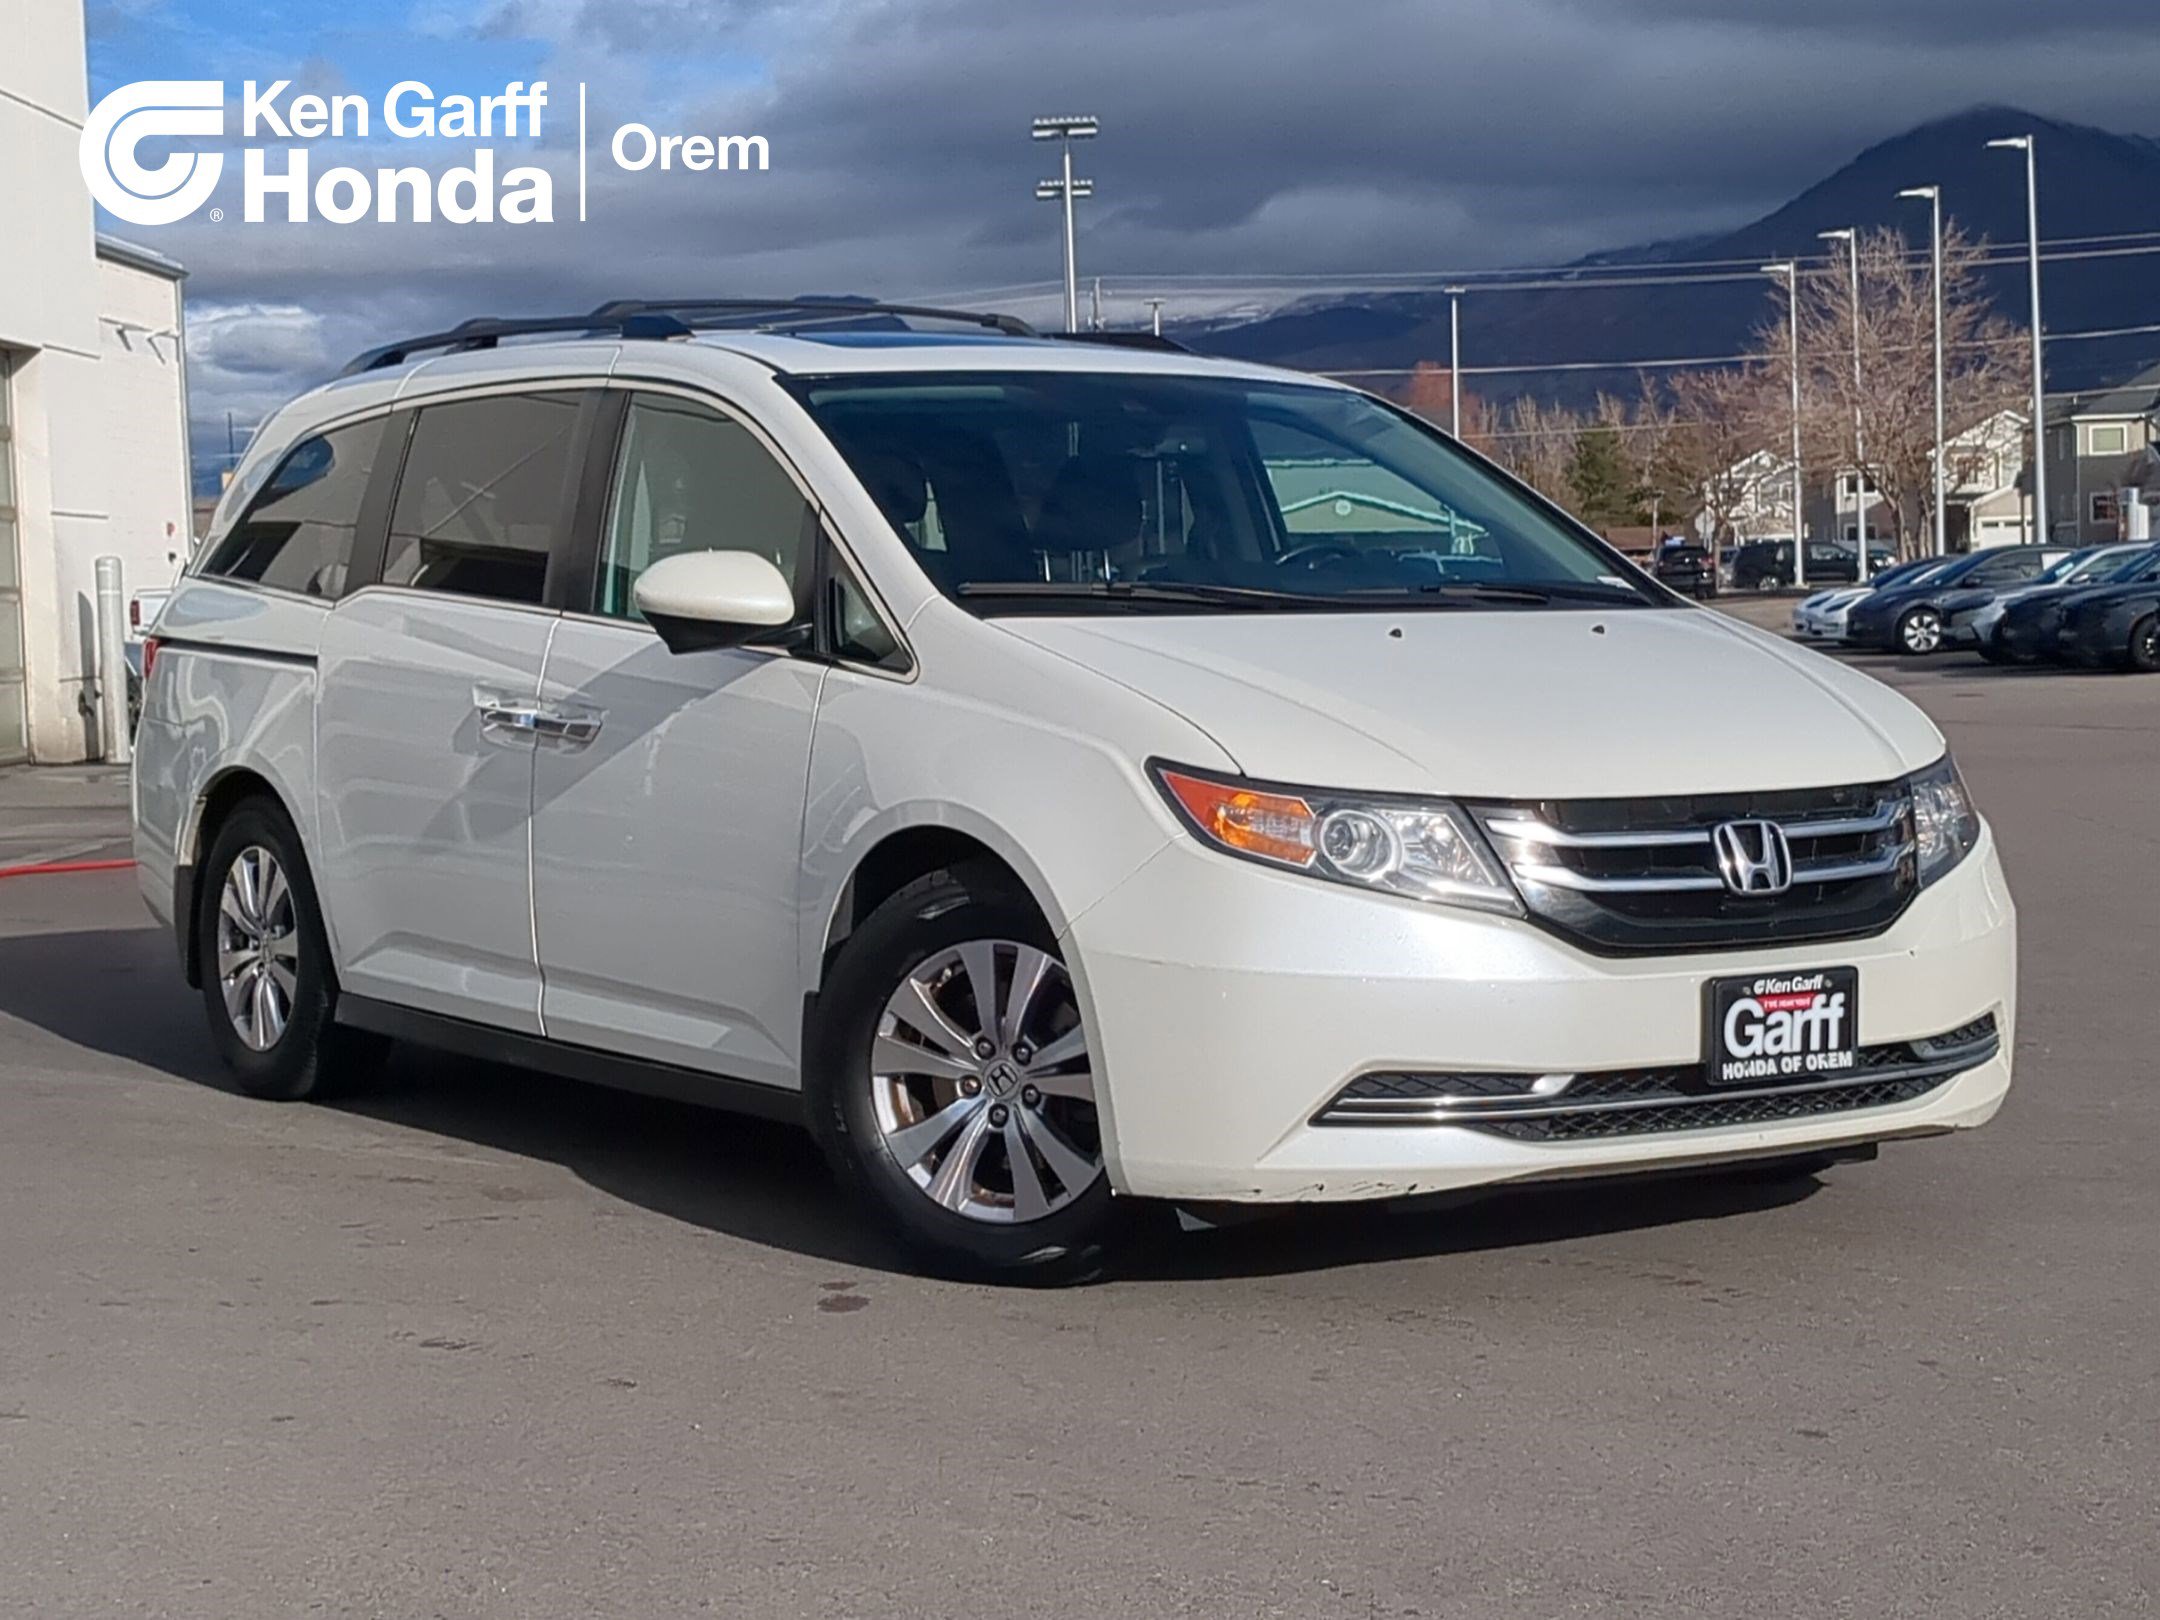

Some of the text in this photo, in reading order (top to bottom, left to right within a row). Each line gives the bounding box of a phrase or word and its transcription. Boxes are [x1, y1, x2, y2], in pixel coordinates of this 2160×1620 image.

[1765, 973, 1824, 995] Ken Garff
[1723, 991, 1846, 1060] Garff
[1721, 1050, 1853, 1081] HONDA OF OREM
